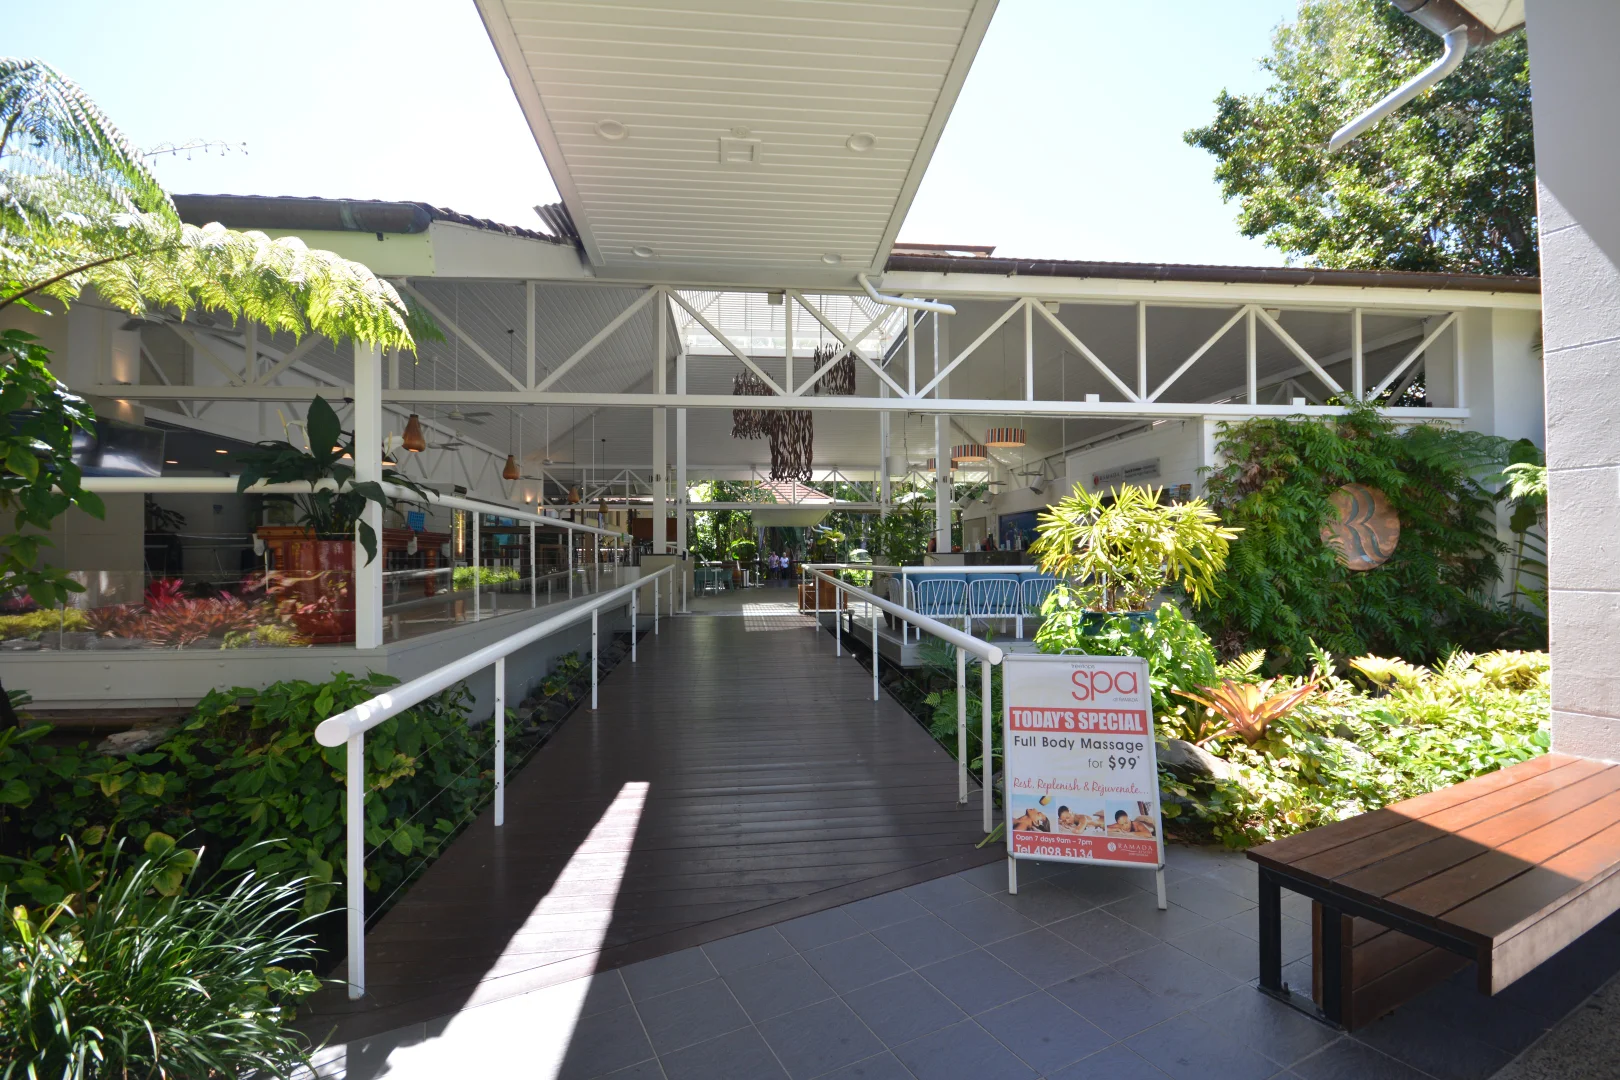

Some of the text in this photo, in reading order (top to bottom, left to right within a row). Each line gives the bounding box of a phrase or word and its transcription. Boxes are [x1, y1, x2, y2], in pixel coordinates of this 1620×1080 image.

[1071, 670, 1138, 701] spa
[1012, 710, 1143, 731] TODAY'S SPECIAL
[1014, 735, 1143, 753] Full Body Massage
[1088, 758, 1103, 769] for
[1037, 778, 1081, 794] Replenish
[1084, 782, 1090, 791] &
[1016, 834, 1033, 842] Open
[1040, 835, 1055, 843] days
[1057, 836, 1071, 844] 9am
[1078, 838, 1093, 846] 7pm
[1118, 842, 1153, 851] RAMADA
[1016, 844, 1094, 859] Tel 4098 5134
